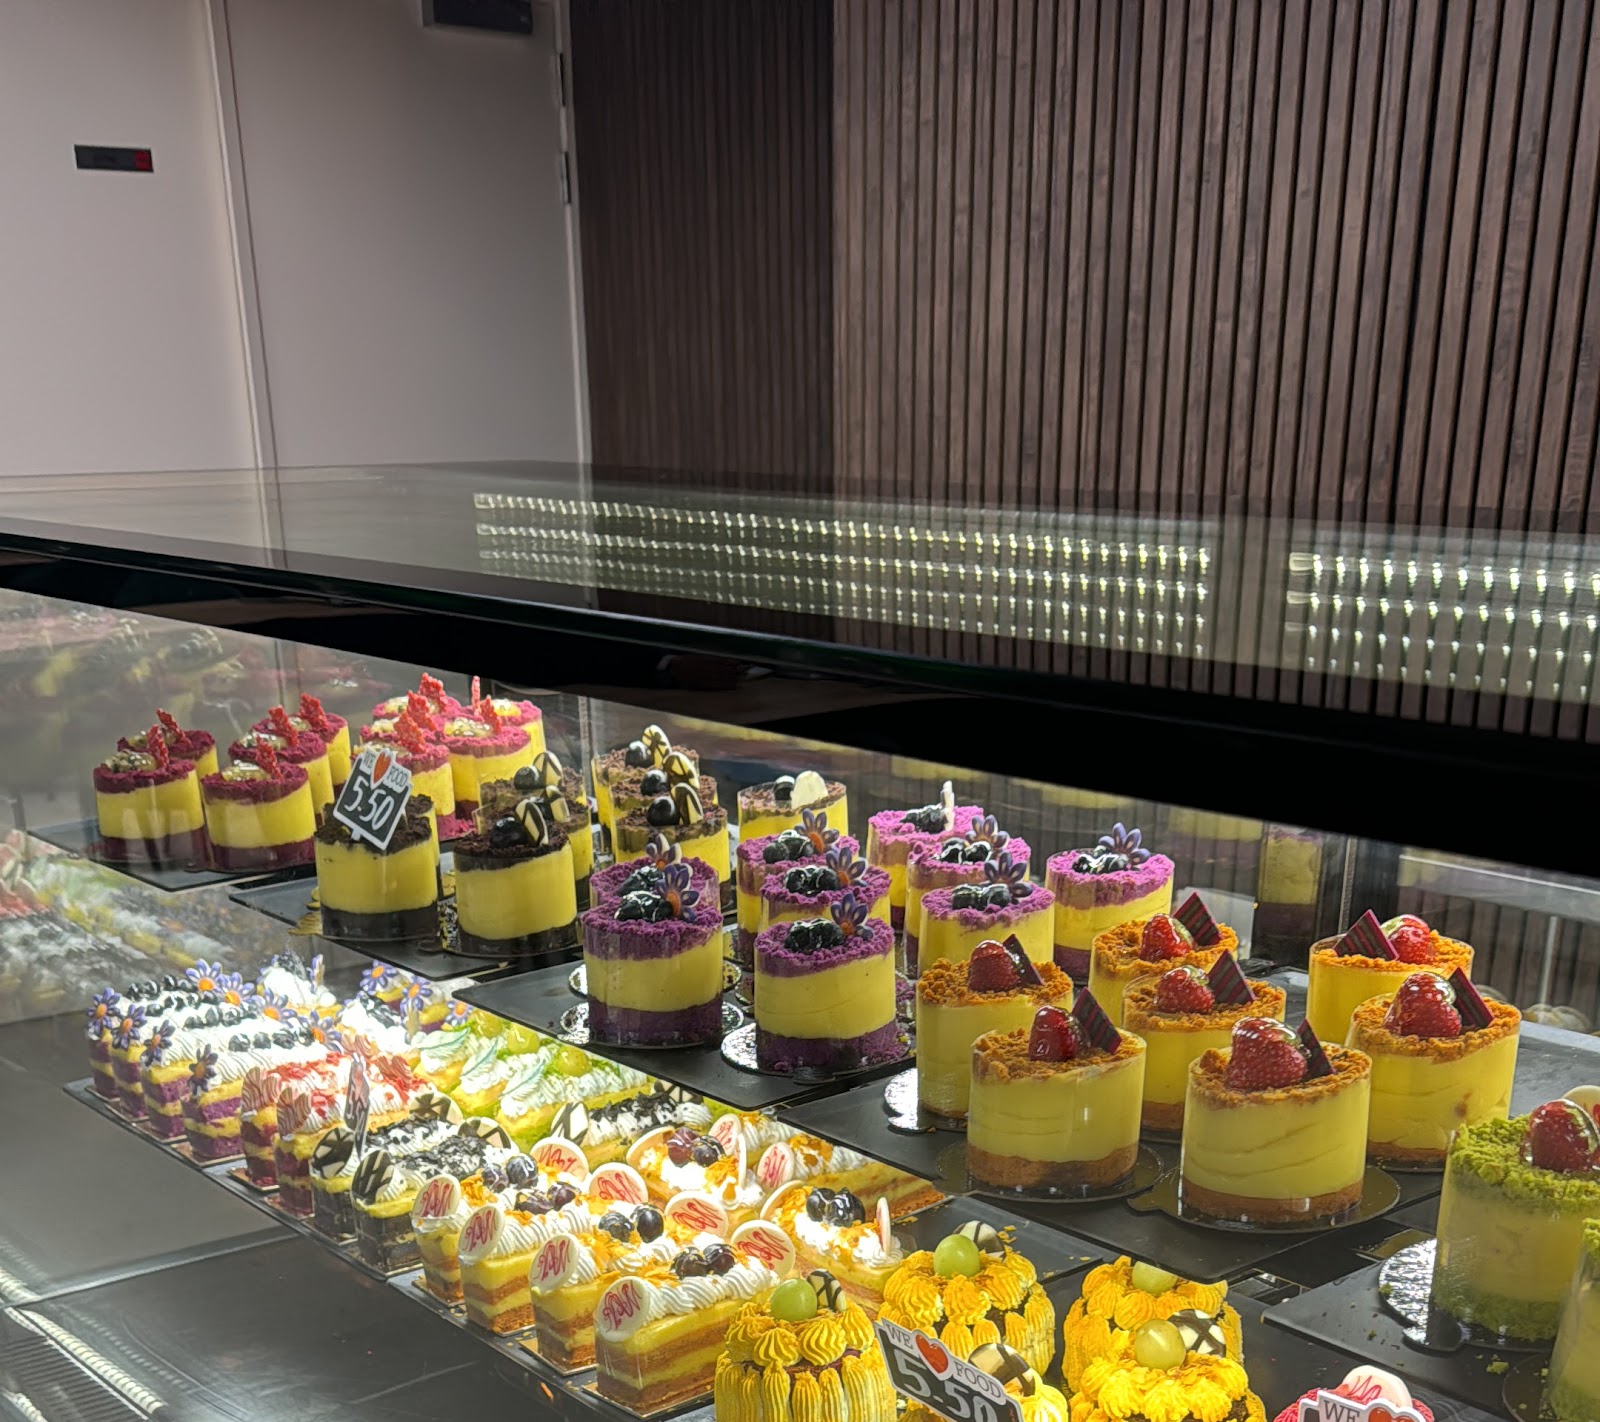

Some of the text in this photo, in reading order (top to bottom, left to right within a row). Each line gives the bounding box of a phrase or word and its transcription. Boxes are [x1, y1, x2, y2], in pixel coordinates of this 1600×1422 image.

[344, 775, 395, 831] 5.50
[387, 765, 408, 787] FOOD
[885, 1324, 1001, 1398] WE FOOD
